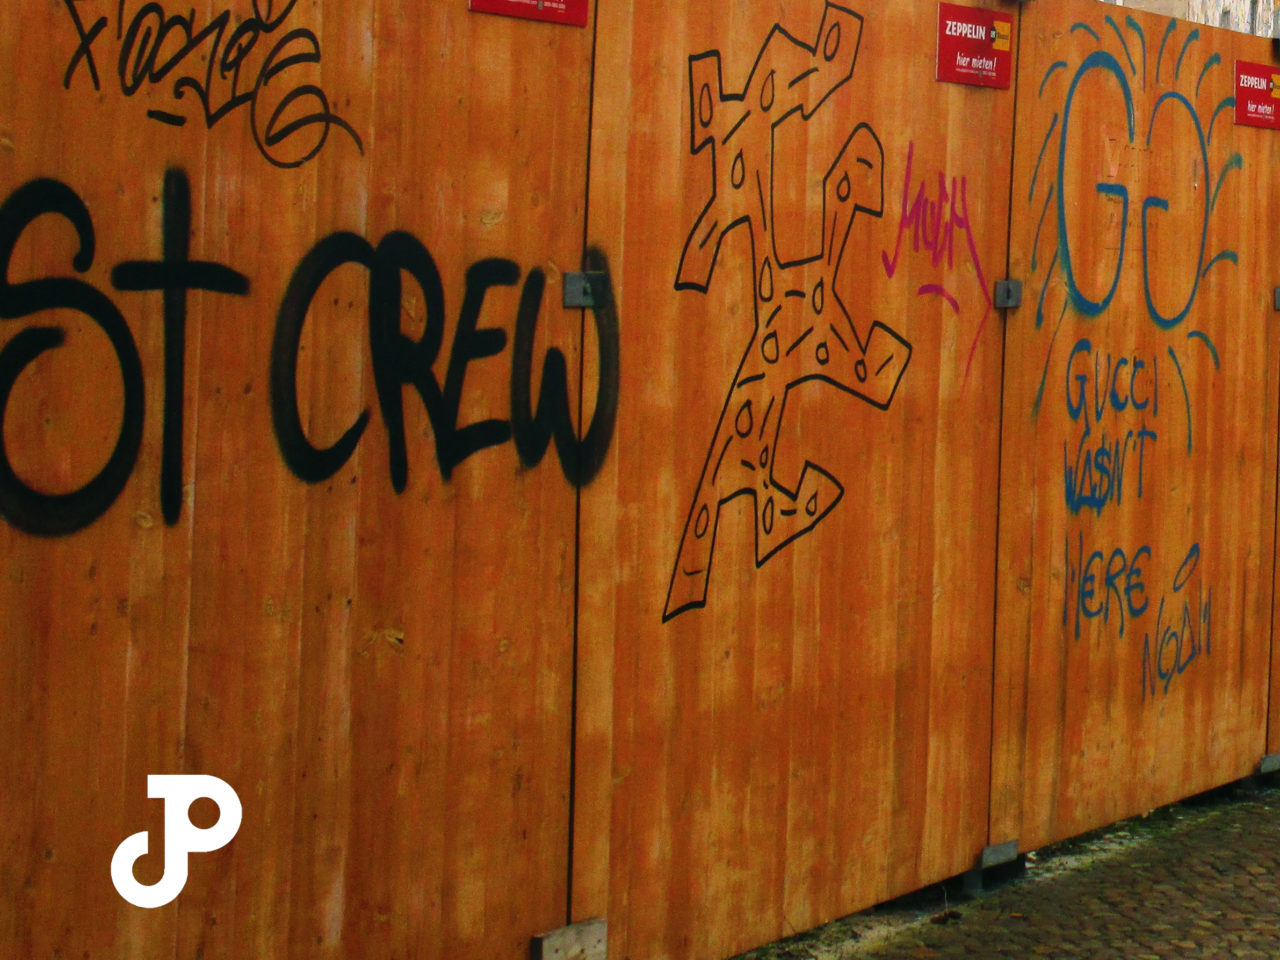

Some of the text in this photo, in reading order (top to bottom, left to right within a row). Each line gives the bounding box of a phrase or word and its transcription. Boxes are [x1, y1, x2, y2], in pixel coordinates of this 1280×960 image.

[945, 20, 986, 40] ZEPPELIN
[956, 52, 971, 67] hier
[1239, 74, 1267, 90] ZEPPELIN
[270, 230, 621, 494] CREW
[1066, 338, 1158, 424] GUCCI
